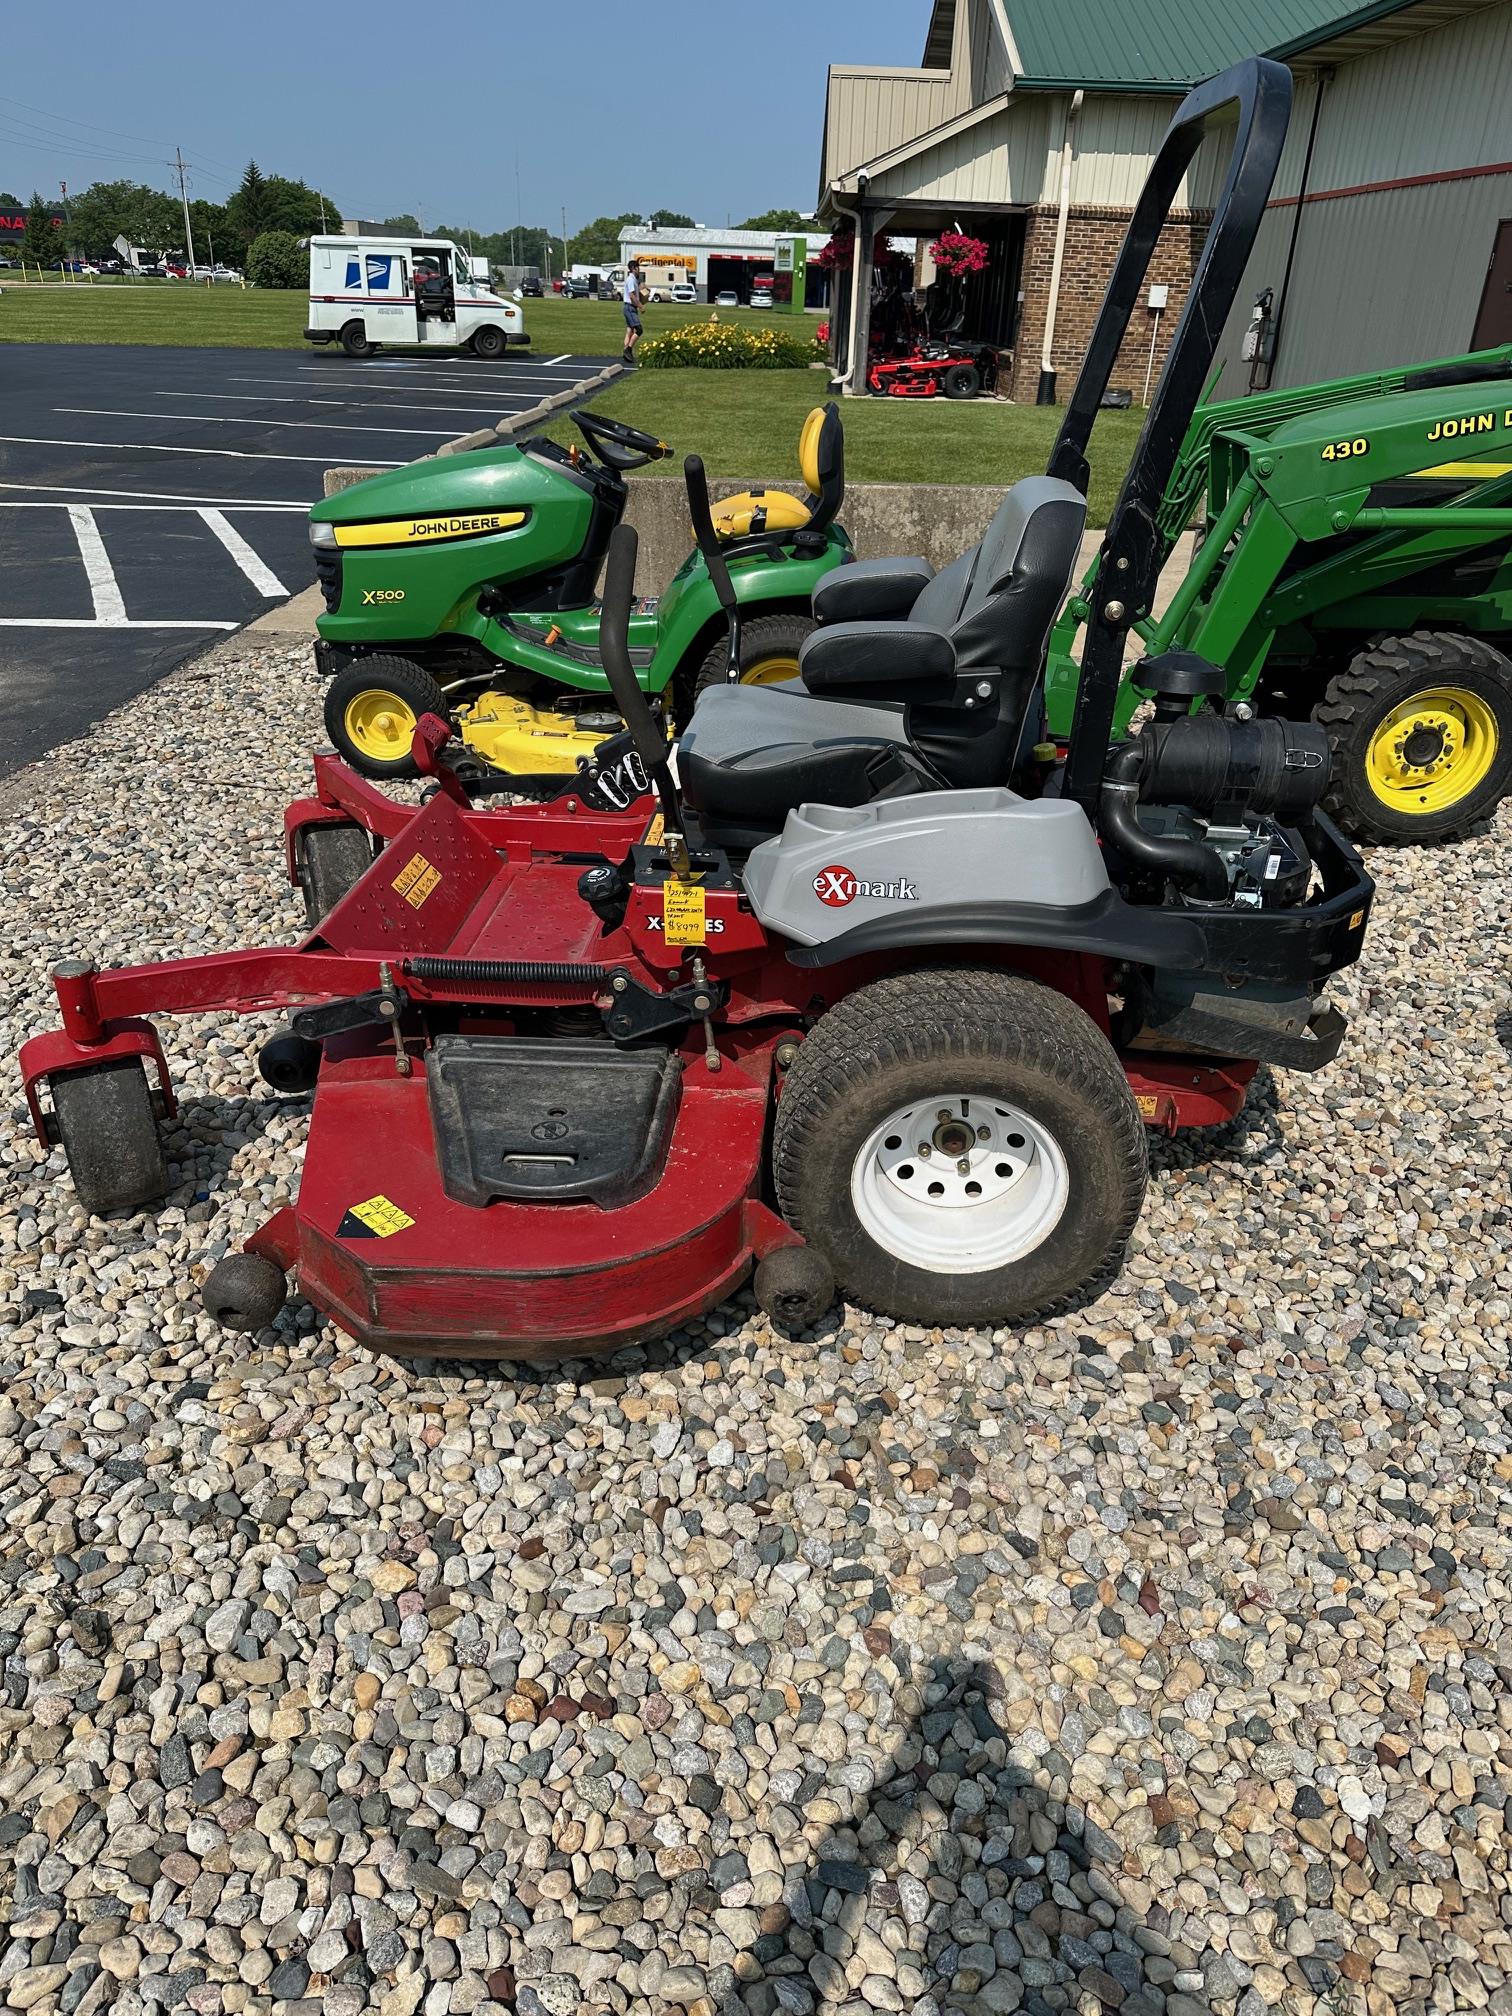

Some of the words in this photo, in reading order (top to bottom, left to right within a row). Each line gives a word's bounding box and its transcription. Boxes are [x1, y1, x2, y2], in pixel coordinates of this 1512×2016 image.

[1427, 413, 1494, 440] JOHN
[1321, 438, 1368, 461] 430
[408, 522, 448, 536] JOHN
[450, 517, 500, 532] DEERE
[362, 590, 405, 605] X500
